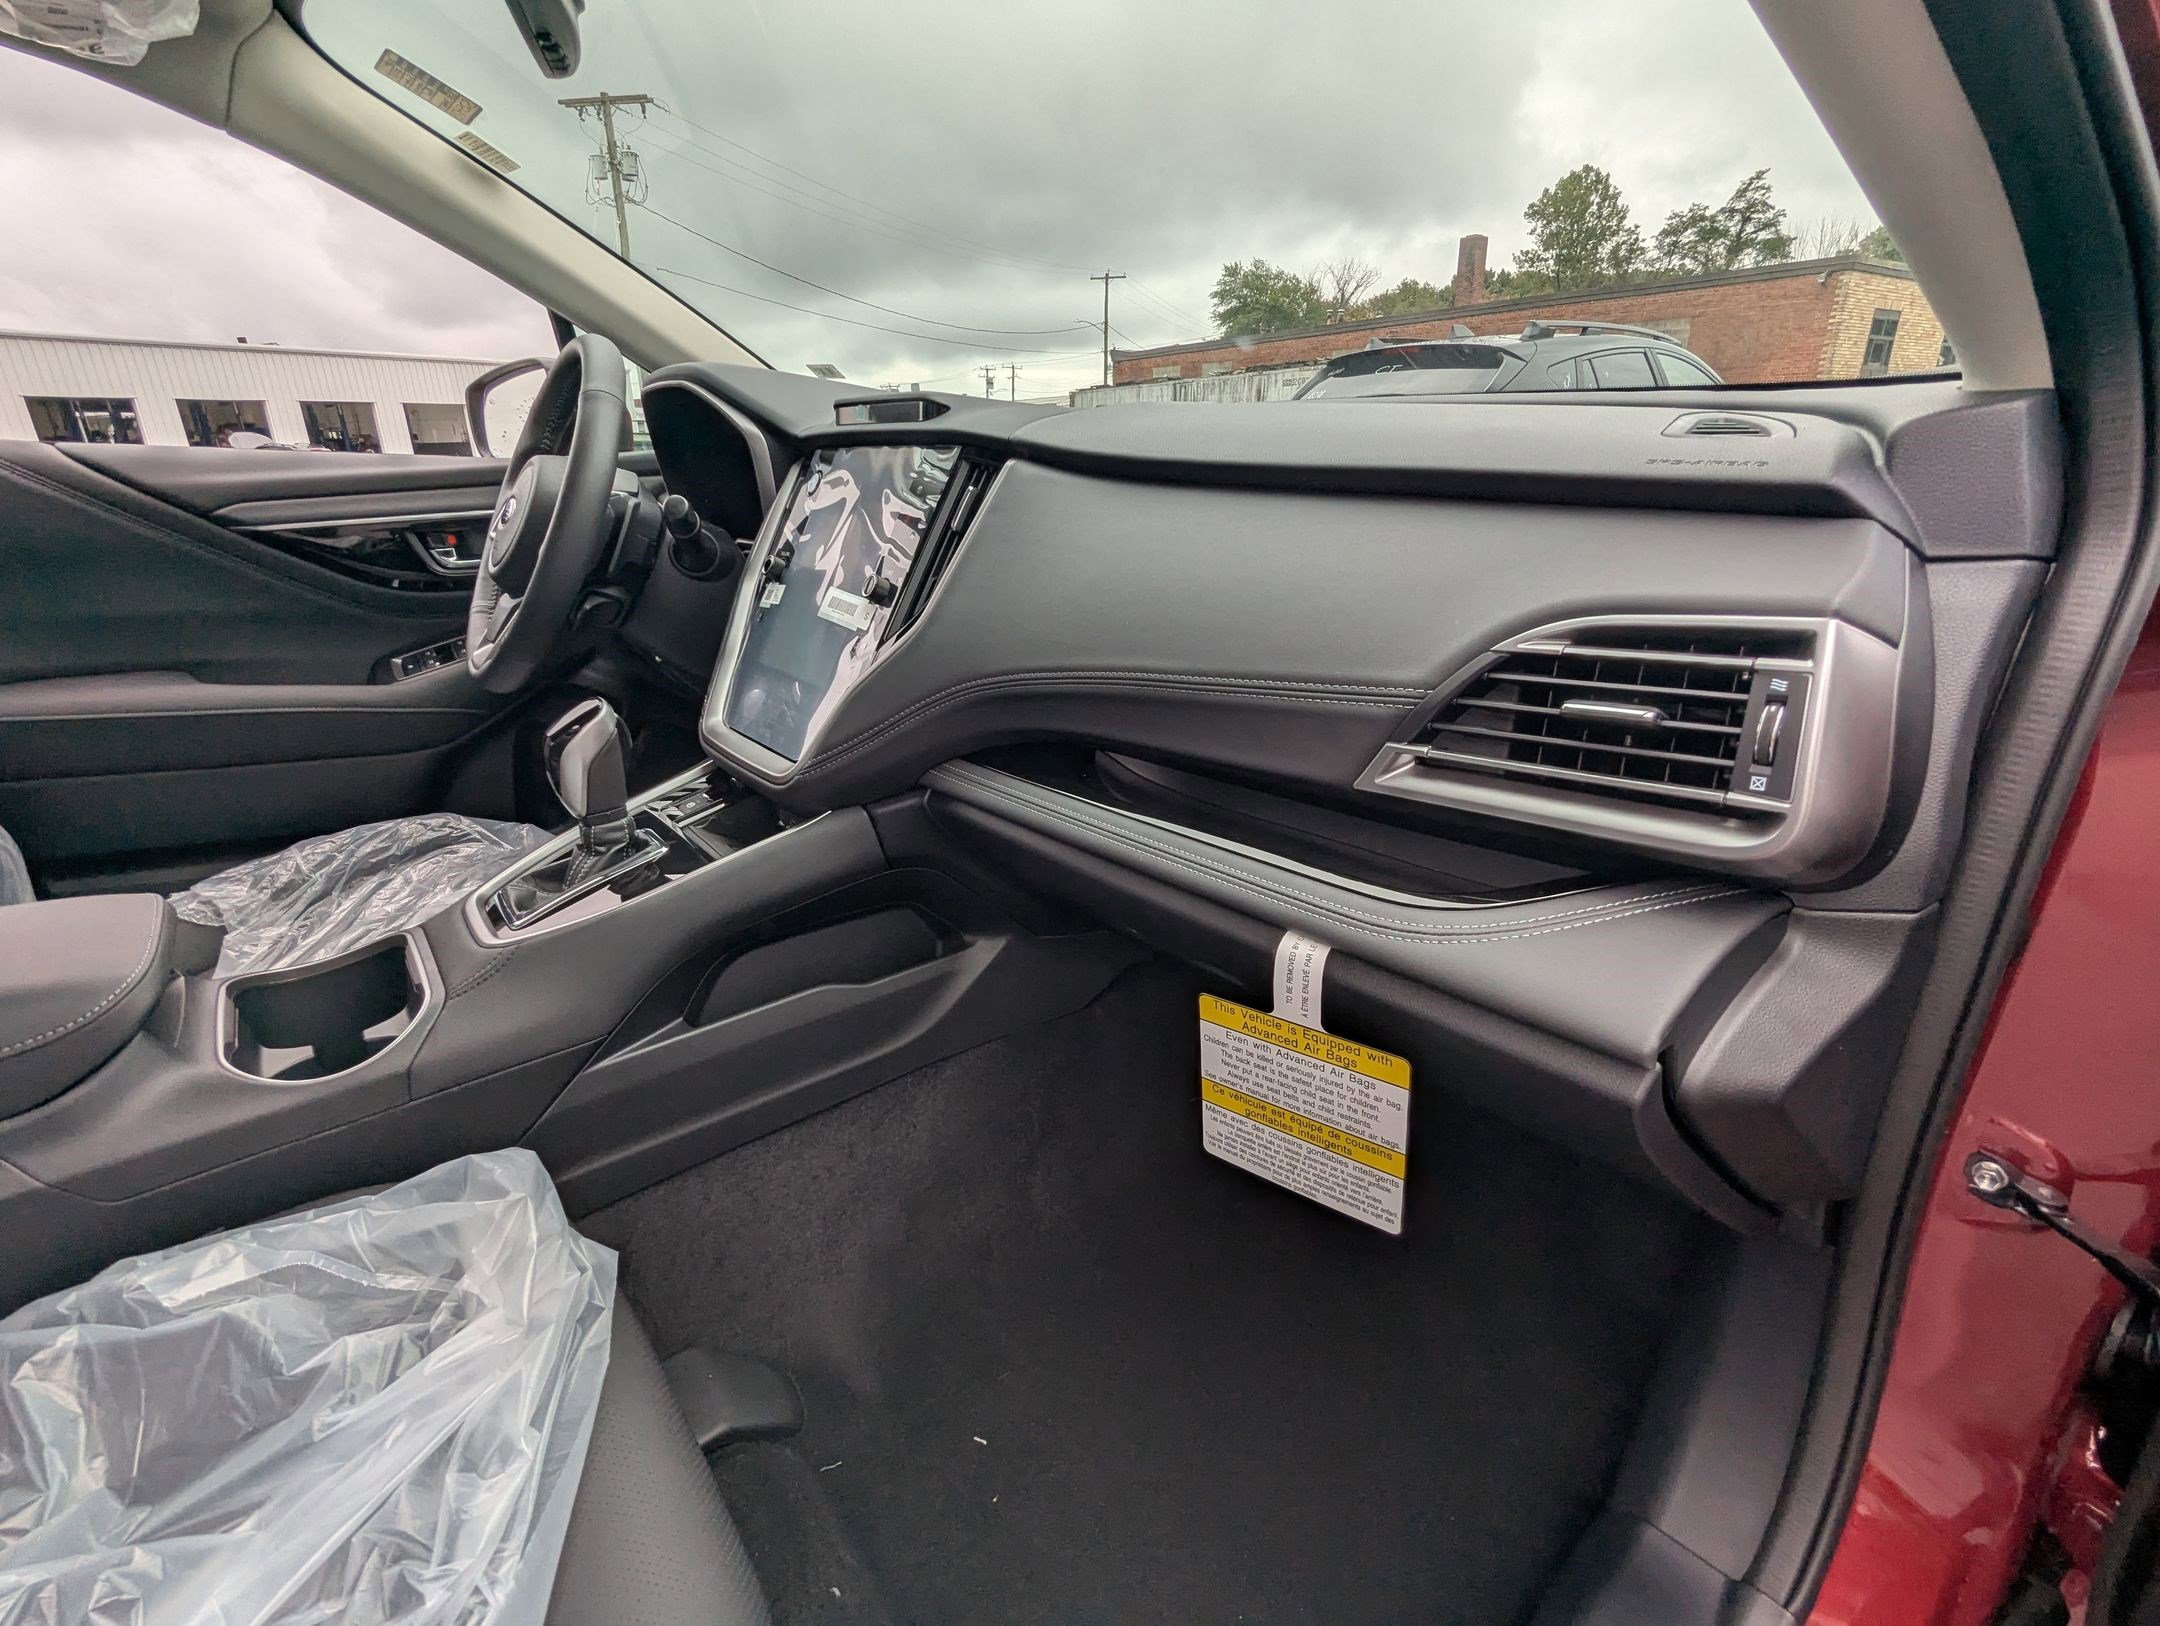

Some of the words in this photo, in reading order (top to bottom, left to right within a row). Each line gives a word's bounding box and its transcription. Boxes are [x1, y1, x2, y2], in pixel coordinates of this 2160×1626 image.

[1286, 951, 1297, 984] REMOVED
[1291, 942, 1301, 950] BY
[1305, 953, 1314, 967] PAR
[1285, 984, 1294, 994] BE
[1285, 995, 1294, 1004] TO
[1213, 999, 1235, 1015] This
[1241, 1009, 1282, 1030] Vehicle
[1288, 1024, 1296, 1035] is
[1303, 1029, 1360, 1057] Equipped
[1367, 1052, 1392, 1067] with
[1242, 1022, 1298, 1048] Advanced
[1304, 1042, 1320, 1055] Air
[1326, 1049, 1357, 1068] Bags
[1204, 1034, 1229, 1048] Children
[1232, 1046, 1243, 1054] can
[1246, 1049, 1254, 1058] be
[1257, 1053, 1273, 1065] killed
[1286, 1065, 1316, 1081] seriously
[1319, 1075, 1343, 1089] injured
[1347, 1085, 1355, 1095] by
[1359, 1089, 1370, 1099] the
[1221, 1049, 1233, 1059] The
[1236, 1055, 1250, 1066] back
[1253, 1063, 1267, 1072] seat
[1278, 1071, 1288, 1079] the
[1292, 1076, 1312, 1088] safest
[1315, 1085, 1334, 1096] place
[1337, 1091, 1347, 1100] for
[1226, 1031, 1248, 1046] Even
[1253, 1042, 1271, 1054] with
[1276, 1049, 1325, 1072] Advanced
[1330, 1067, 1344, 1078] Air
[1349, 1073, 1376, 1090] Bags
[1205, 1070, 1216, 1080] See
[1219, 1077, 1243, 1090] owner's
[1246, 1087, 1269, 1100] manual
[1272, 1096, 1280, 1104] for
[1283, 1101, 1300, 1112] more
[1304, 1107, 1341, 1127] information
[1345, 1124, 1365, 1136] about
[1221, 1058, 1239, 1070] Never
[1242, 1068, 1252, 1076] put
[1262, 1075, 1297, 1094] rear-facing
[1300, 1089, 1316, 1099] child
[1319, 1096, 1334, 1106] seat
[1347, 1105, 1358, 1114] the
[1227, 1070, 1249, 1083] Always
[1252, 1081, 1264, 1089] use
[1267, 1086, 1280, 1095] seat
[1283, 1091, 1299, 1102] belts
[1302, 1099, 1315, 1108] and
[1318, 1105, 1334, 1115] child
[1213, 1084, 1224, 1095] Ce
[1229, 1092, 1267, 1111] véhicule
[1271, 1109, 1285, 1119] est
[1290, 1115, 1323, 1133] équipé
[1328, 1130, 1340, 1140] de
[1345, 1138, 1392, 1160] coussins
[1245, 1108, 1293, 1135] gonflables
[1298, 1127, 1352, 1155] intelligents
[1231, 1116, 1248, 1127] avec
[1252, 1124, 1265, 1134] des
[1268, 1131, 1303, 1150] coussins
[1306, 1147, 1348, 1168] gonflables
[1353, 1165, 1399, 1188] intelligents
